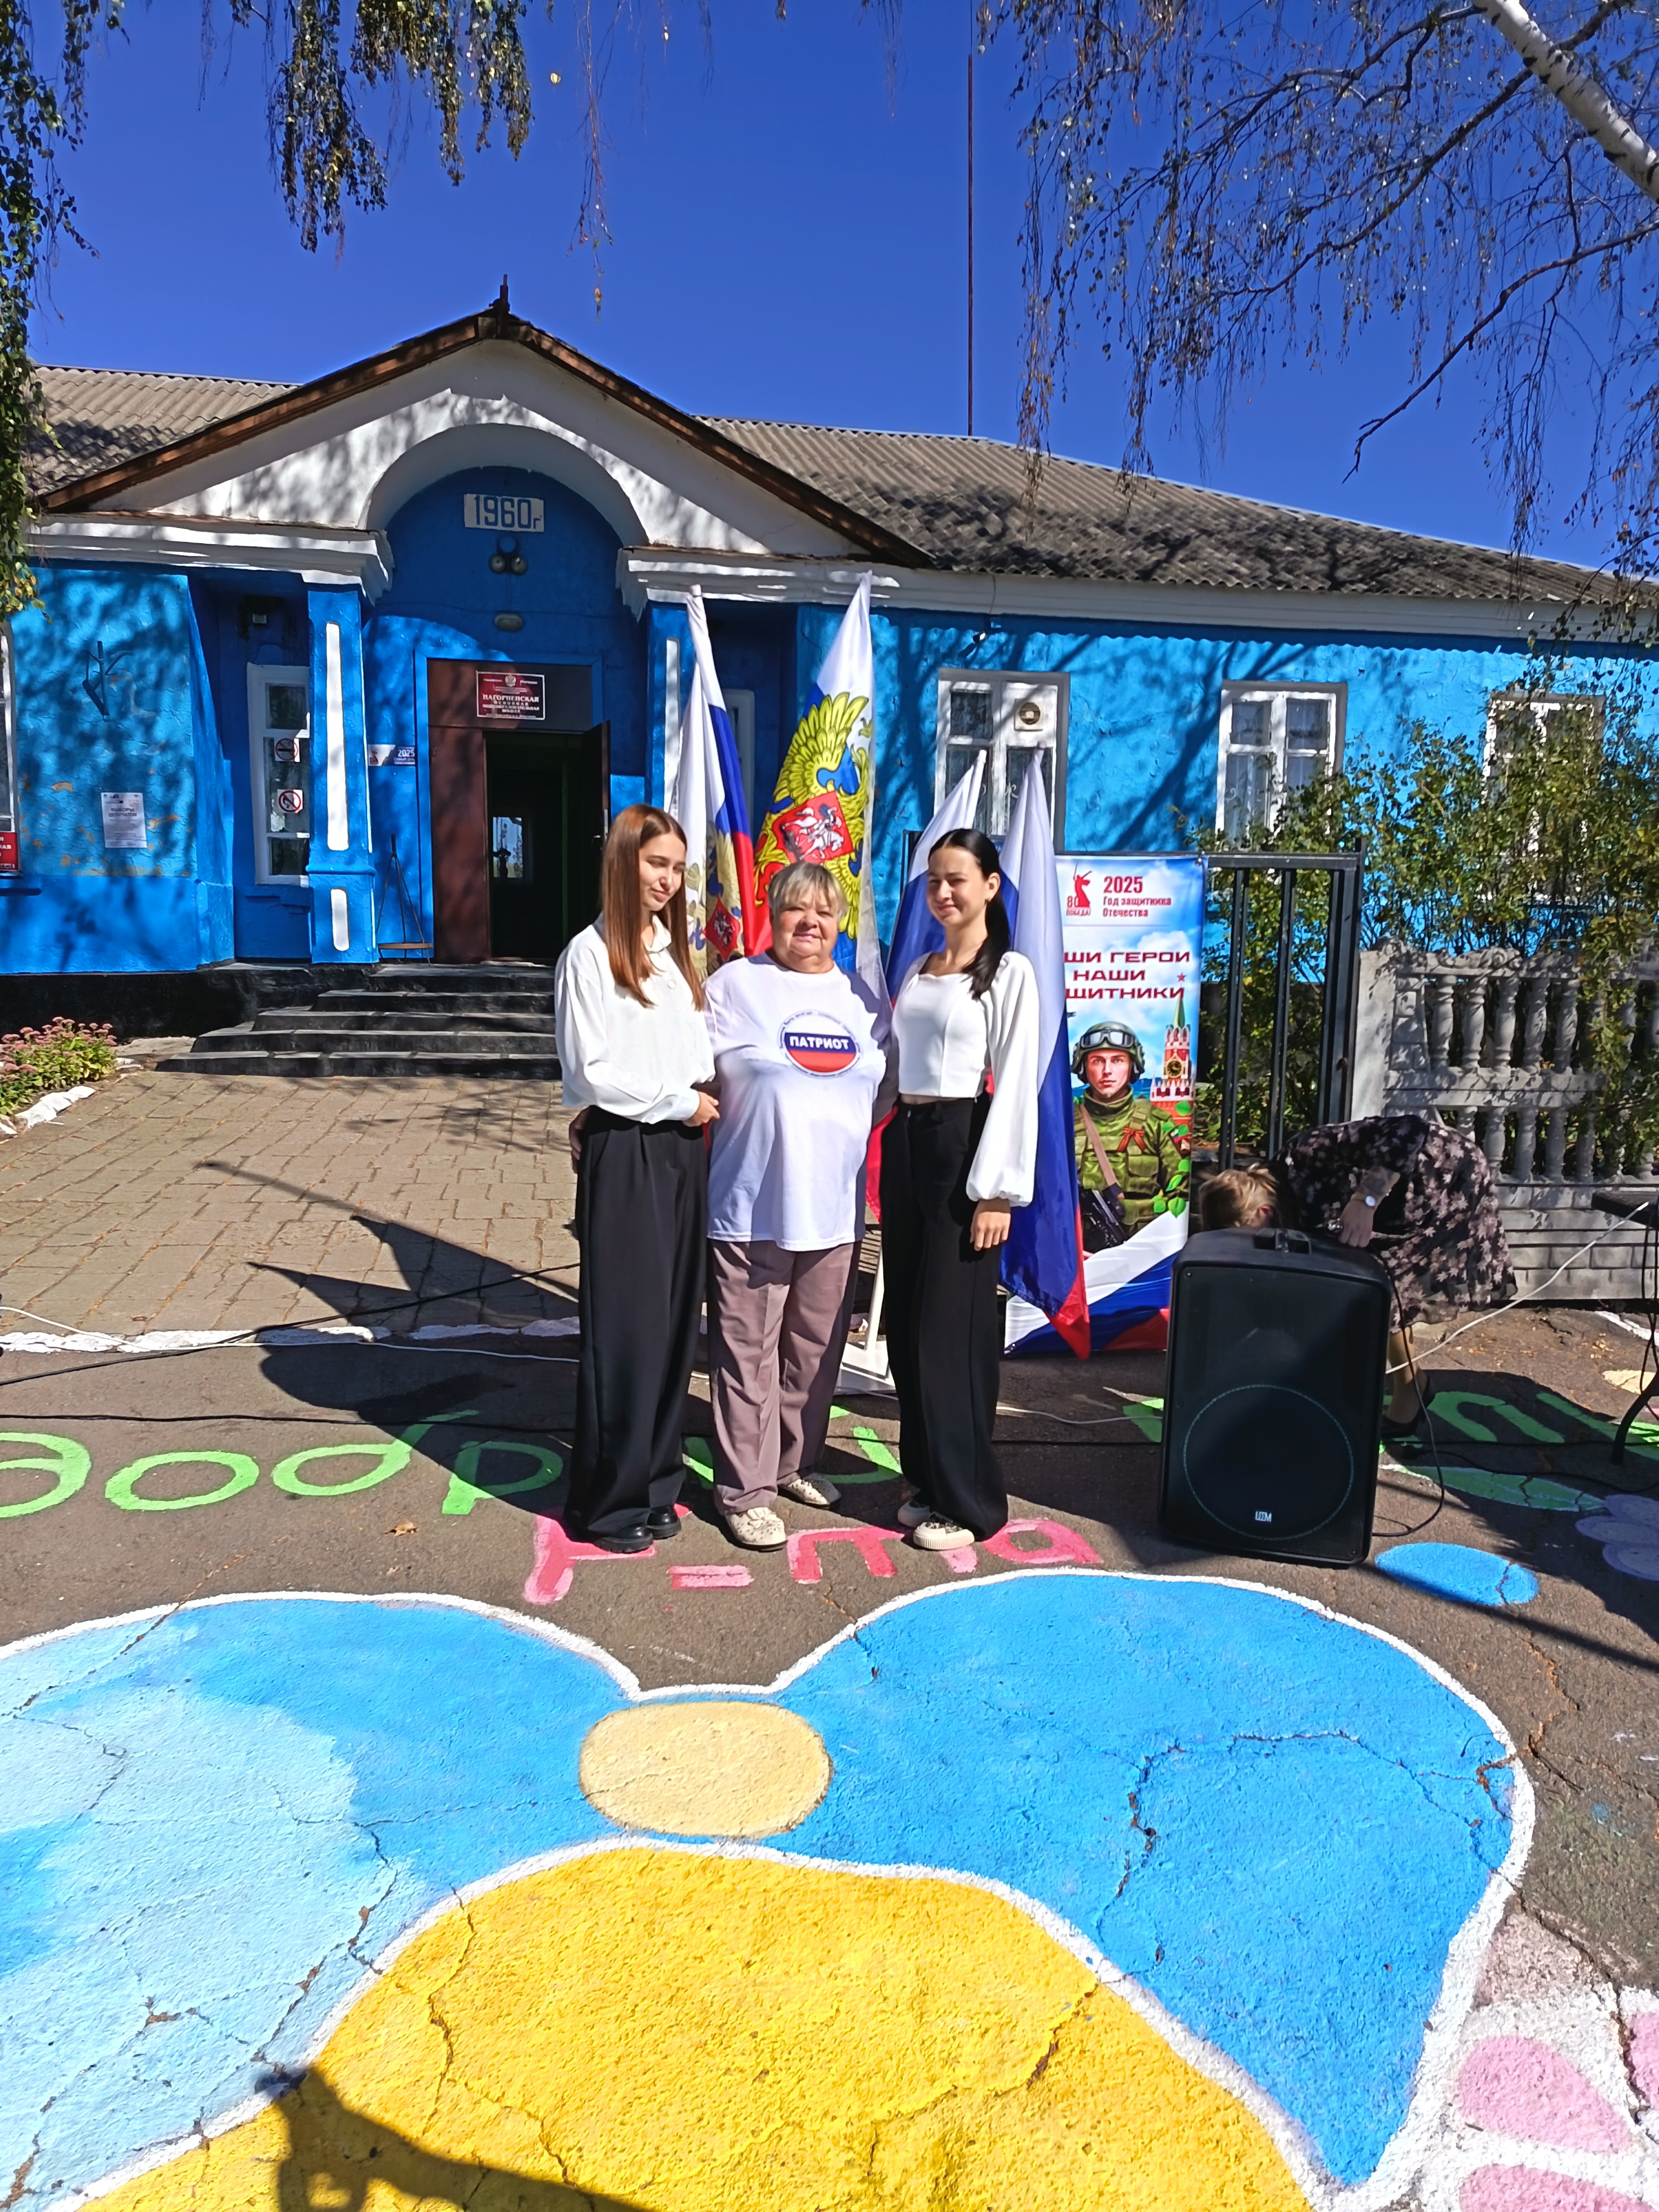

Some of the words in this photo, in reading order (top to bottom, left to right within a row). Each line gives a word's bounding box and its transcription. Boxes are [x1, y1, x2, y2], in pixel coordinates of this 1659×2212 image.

[398, 749, 415, 757] 2025
[1103, 876, 1144, 894] 2025
[1103, 896, 1119, 906] Год
[1121, 898, 1172, 907] защитника
[1102, 908, 1149, 917] Отечества
[1063, 952, 1102, 963] ШИ
[1110, 951, 1191, 963] ГЕРОИ
[1073, 969, 1146, 982] НАШИ
[1066, 987, 1185, 1000] ЩИТНИКИ
[789, 1035, 849, 1050] ПАТРИОТ
